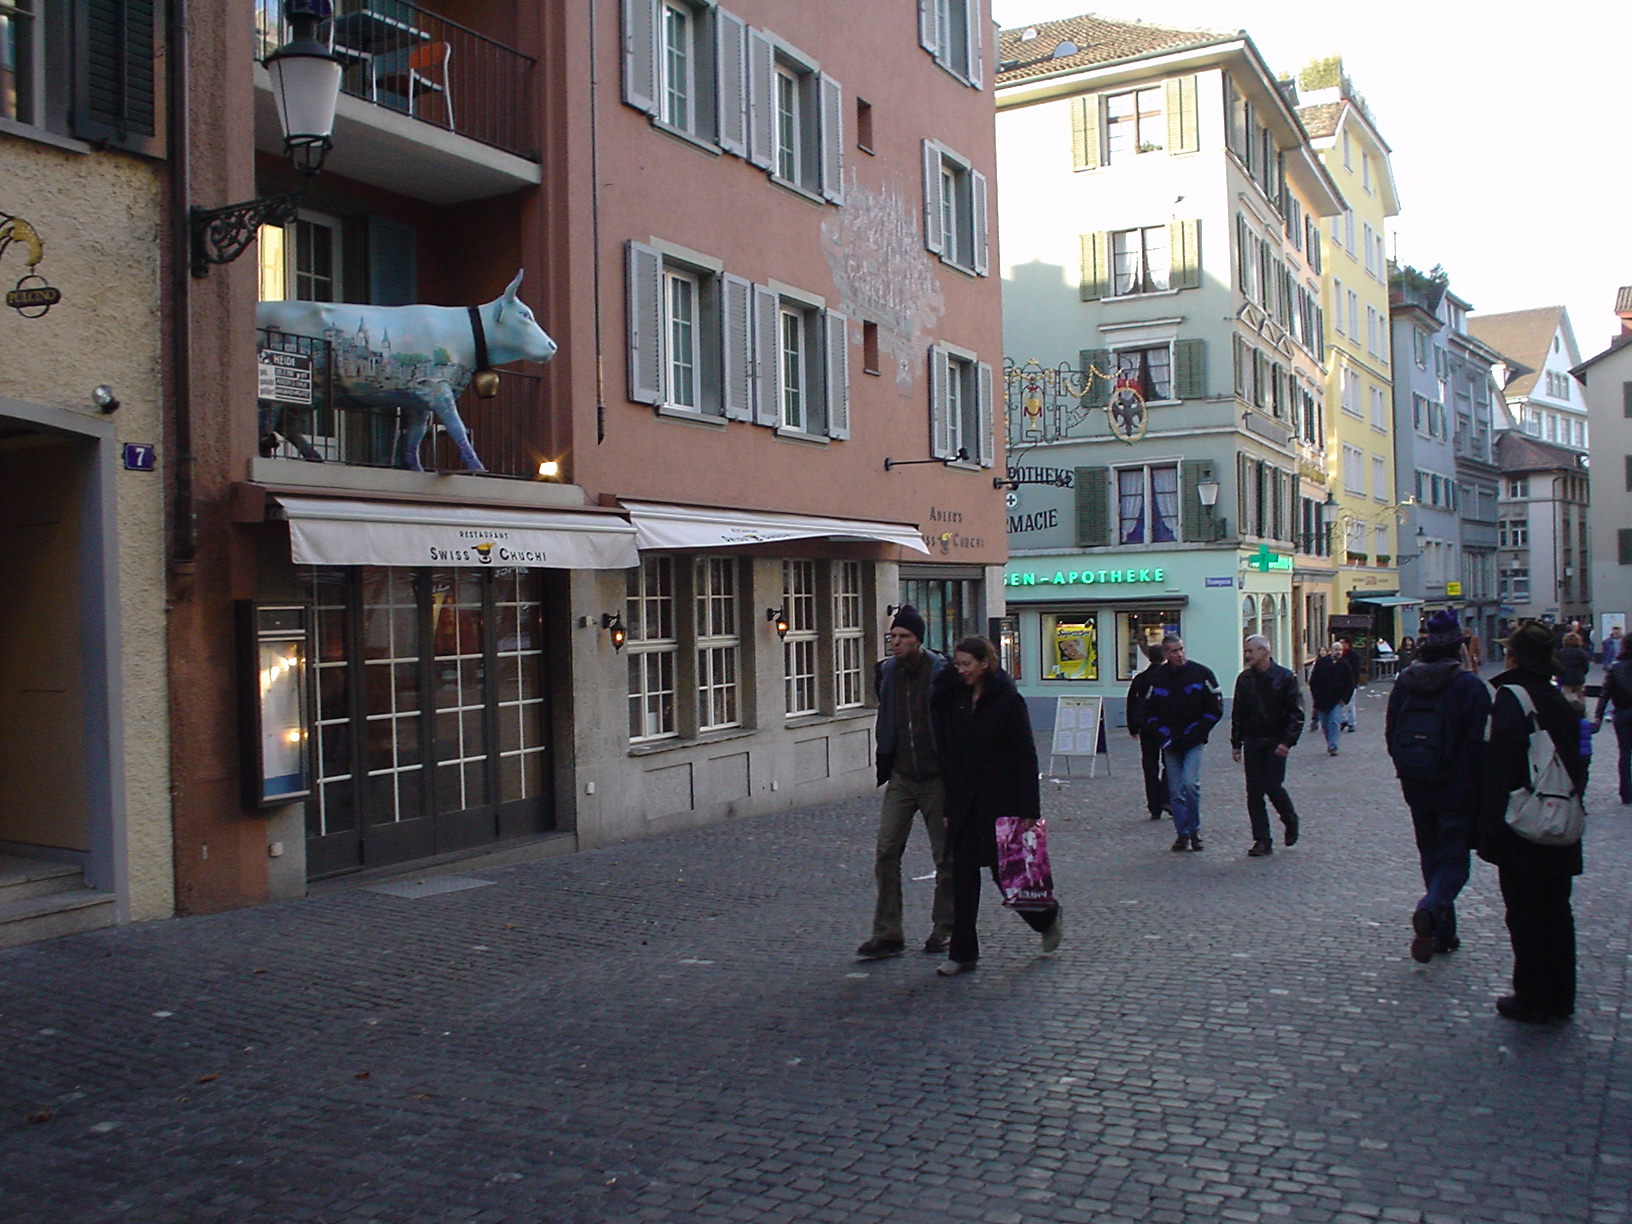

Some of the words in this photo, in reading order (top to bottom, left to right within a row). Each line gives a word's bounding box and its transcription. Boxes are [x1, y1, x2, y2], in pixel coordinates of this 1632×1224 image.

[136, 447, 145, 467] 7
[1006, 508, 1058, 534] MACIE
[459, 530, 509, 540] RESTAURANT
[430, 546, 470, 561] SWISS
[499, 547, 547, 562] CHUCHI
